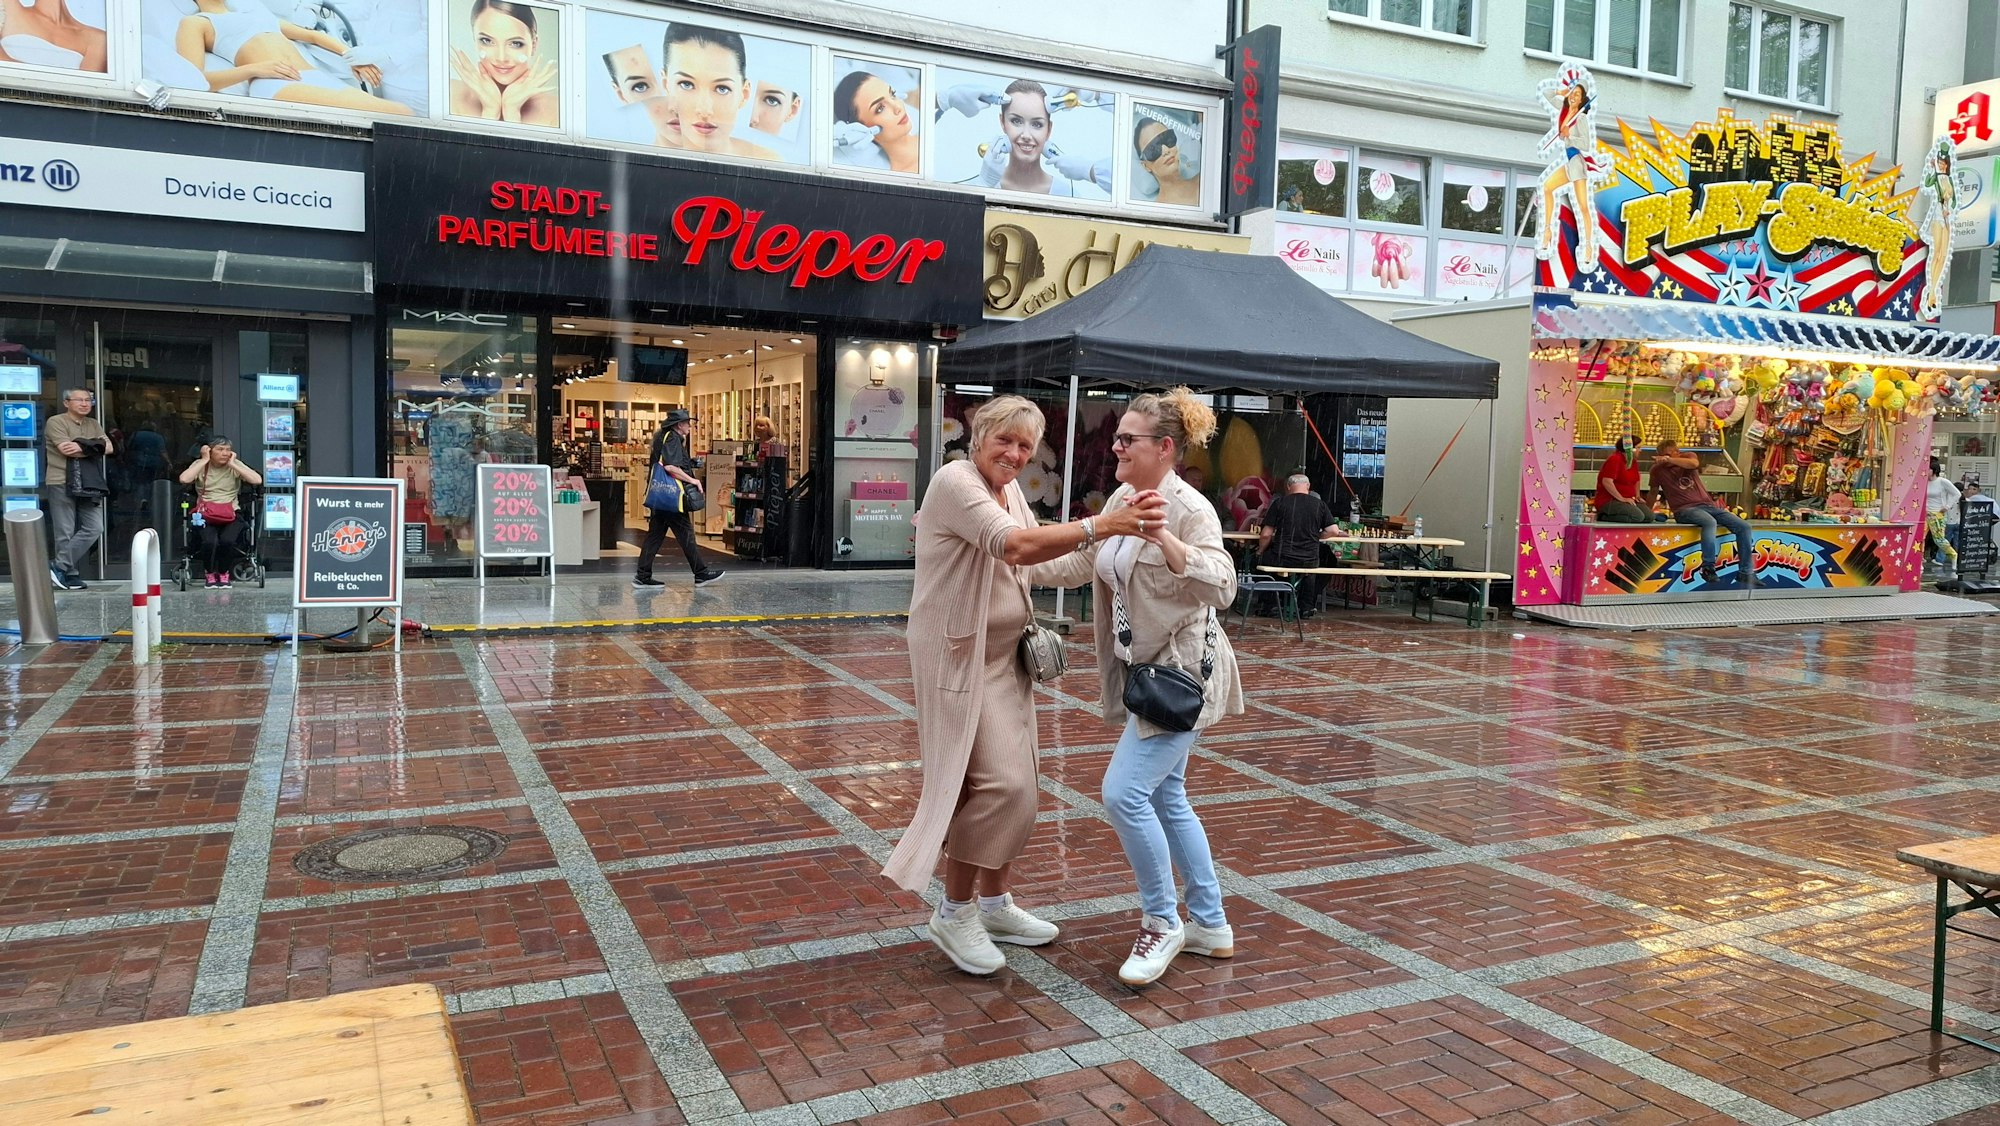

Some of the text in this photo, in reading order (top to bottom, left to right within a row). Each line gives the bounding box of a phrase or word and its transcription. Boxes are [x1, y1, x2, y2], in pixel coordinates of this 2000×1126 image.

[1135, 104, 1202, 140] NEUERÖFFNUNG
[1233, 48, 1261, 195] Pieper
[165, 177, 333, 209] Davide Ciaccia
[491, 180, 611, 218] STADT-
[1954, 220, 1975, 229] ania
[1954, 228, 1976, 237] heke
[438, 214, 659, 262] PARFÜMERIE
[671, 195, 945, 288] Pieper
[1279, 239, 1341, 262] Le Nails
[1443, 255, 1498, 277] Le Nails
[1022, 281, 1058, 316] City
[1356, 407, 1369, 416] Das
[493, 472, 537, 490] 20%
[316, 498, 350, 508] Wurst
[493, 497, 537, 516] 20%
[494, 523, 538, 542] 20%
[314, 572, 383, 582] Reibekuchen
